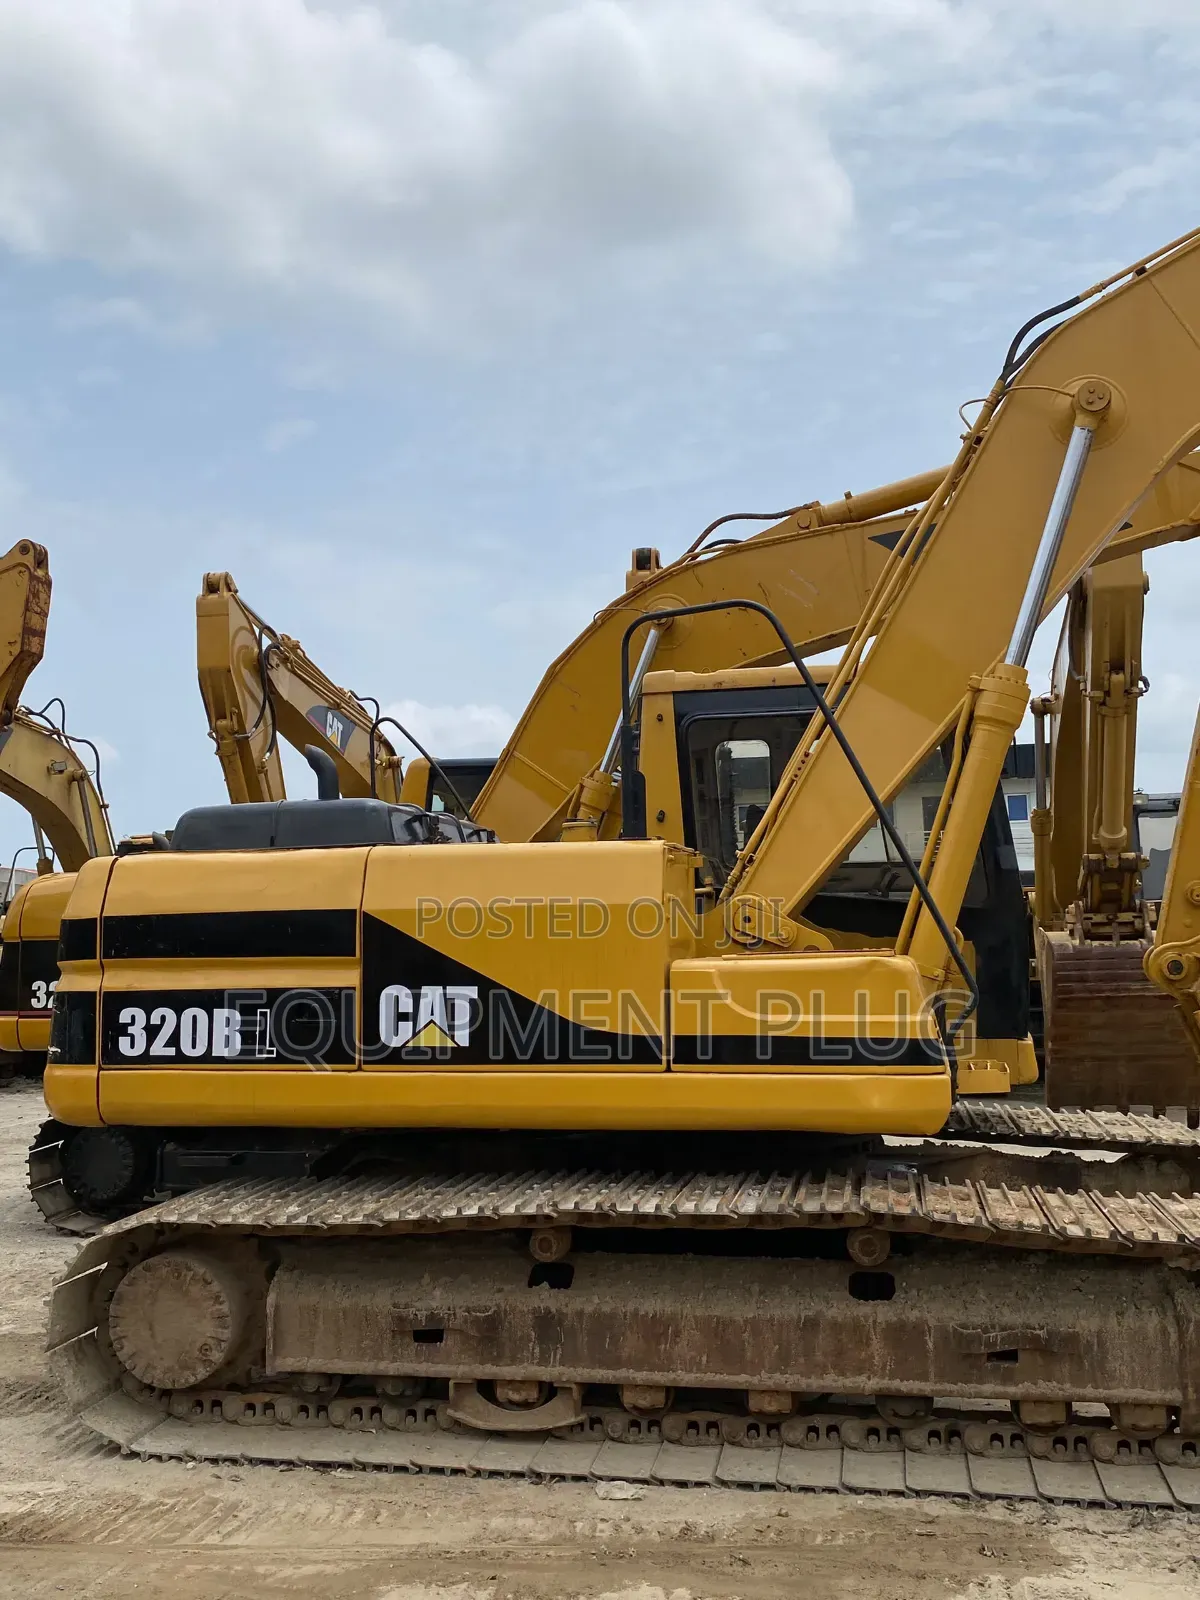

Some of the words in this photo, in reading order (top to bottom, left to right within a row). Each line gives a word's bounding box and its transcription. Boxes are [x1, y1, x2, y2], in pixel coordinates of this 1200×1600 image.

[326, 711, 344, 749] CAT
[118, 1007, 242, 1057] 320B
[379, 984, 479, 1048] CAT
